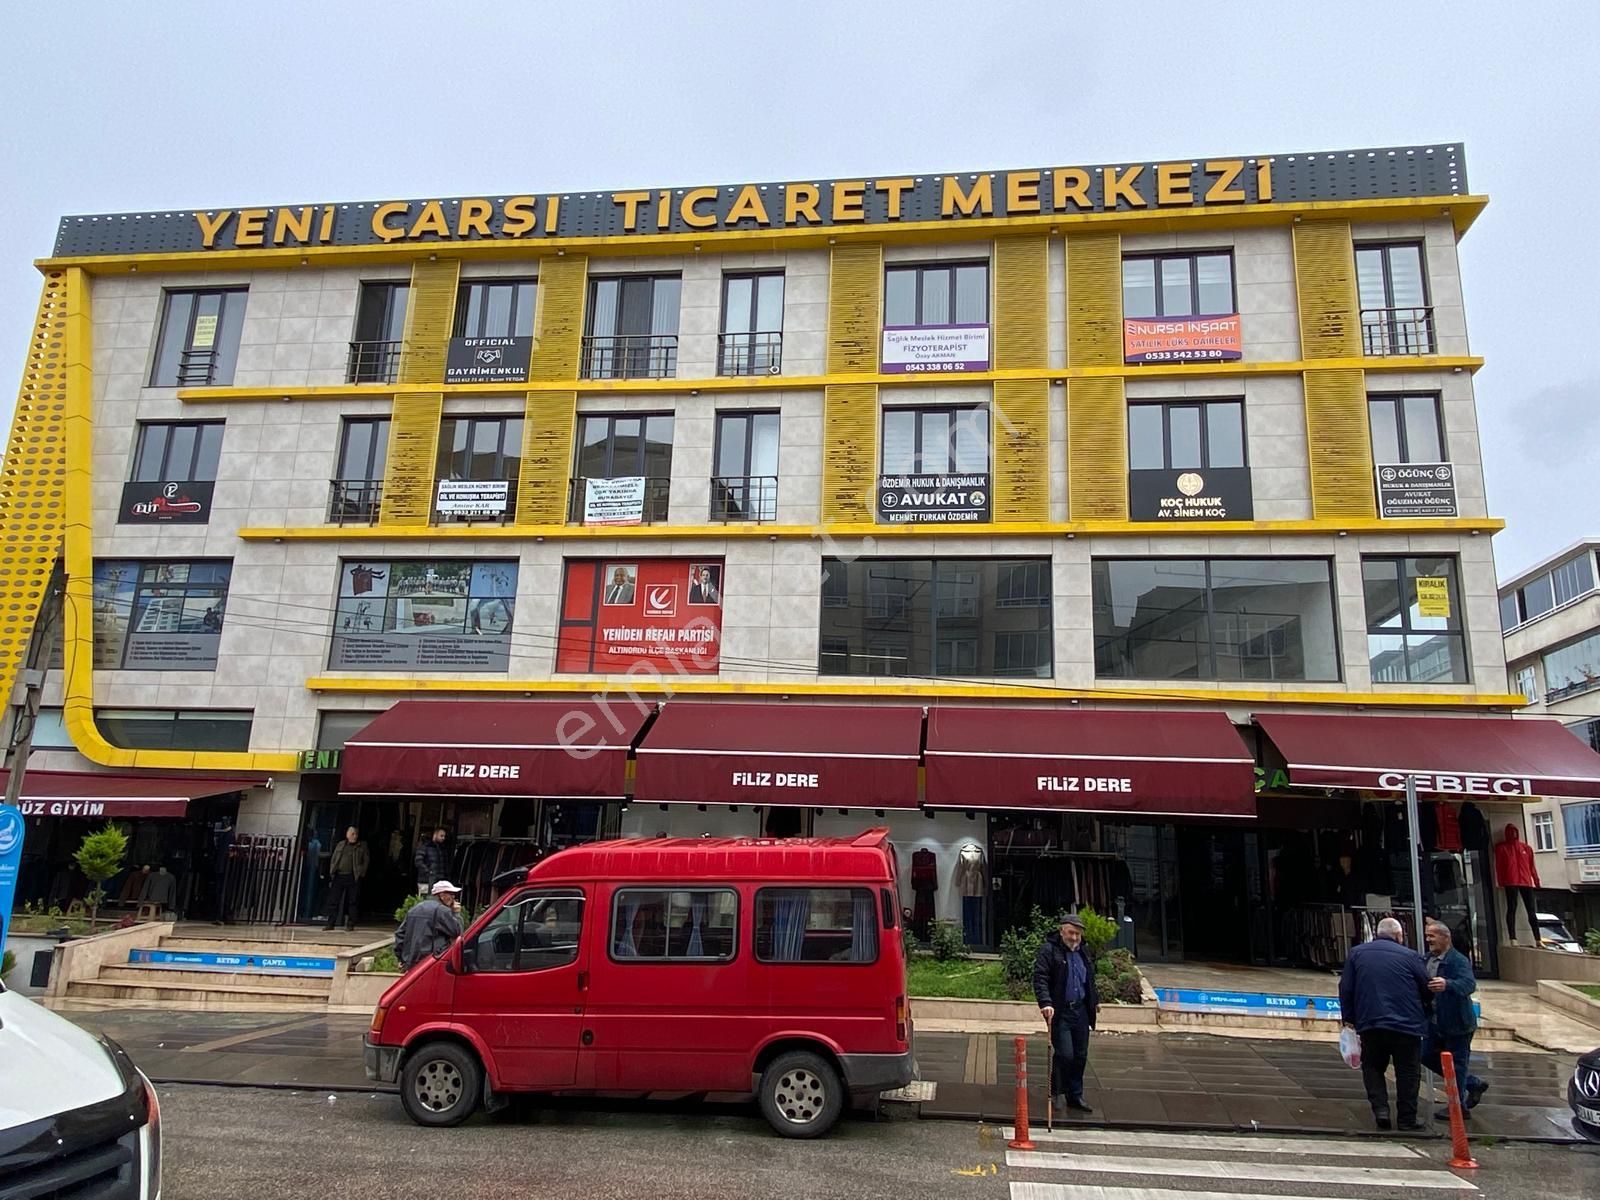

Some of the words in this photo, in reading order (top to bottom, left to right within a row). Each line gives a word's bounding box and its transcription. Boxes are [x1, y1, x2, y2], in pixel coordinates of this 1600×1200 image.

[372, 195, 561, 243] ÇARŞI
[447, 366, 526, 375] GAYRİMENKUL
[905, 363, 924, 371] 0543
[912, 478, 934, 487] HUKUK
[901, 493, 967, 505] AVUKAT
[1160, 499, 1183, 509] KOÇ
[1185, 498, 1221, 507] HUKUK
[890, 512, 918, 521] MEHMET
[920, 512, 945, 521] FURKAN
[947, 511, 978, 521] ÖZDEMİR
[1158, 509, 1172, 517] AV.
[1175, 508, 1203, 517] SİNEM
[1206, 508, 1226, 518] KOÇ
[603, 625, 643, 641] YENİDEN
[645, 628, 676, 641] REFAH
[678, 625, 714, 641] PARTİSİ
[479, 764, 520, 779] DERE
[776, 773, 819, 787] DERE
[1084, 778, 1132, 793] DERE
[51, 801, 104, 815] GİYİM
[262, 959, 286, 967] ÇANTA
[1266, 998, 1296, 1006] RETRO
